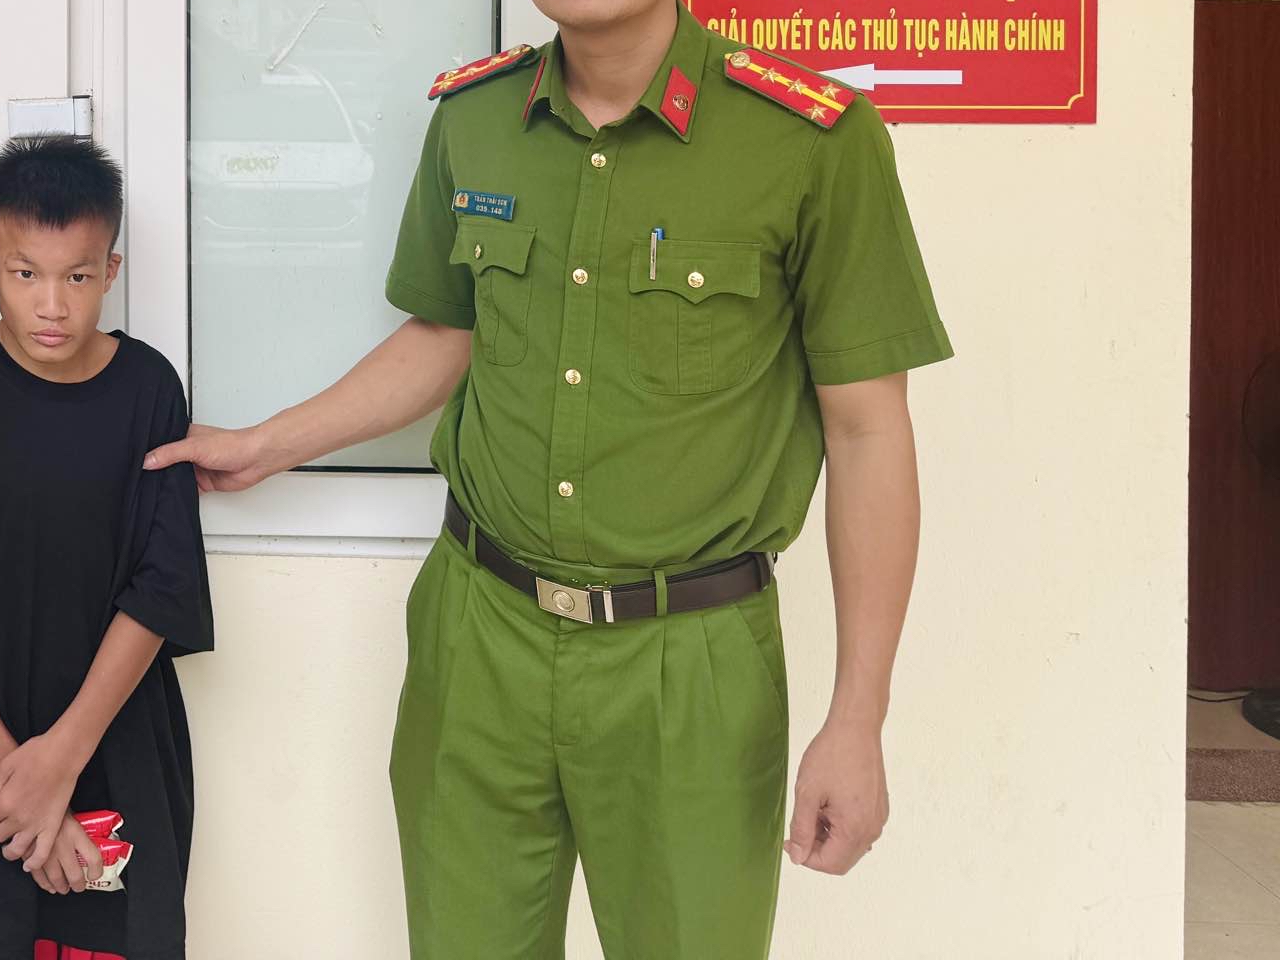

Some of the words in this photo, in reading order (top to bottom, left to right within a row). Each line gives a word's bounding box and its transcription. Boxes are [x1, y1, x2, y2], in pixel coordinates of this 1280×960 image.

[752, 8, 813, 50] QUYẾT
[818, 11, 856, 51] CÁC
[862, 7, 898, 51] THỦ
[903, 18, 941, 58] TỤC
[945, 12, 998, 51] HÀNH
[1004, 12, 1065, 51] CHÍNH
